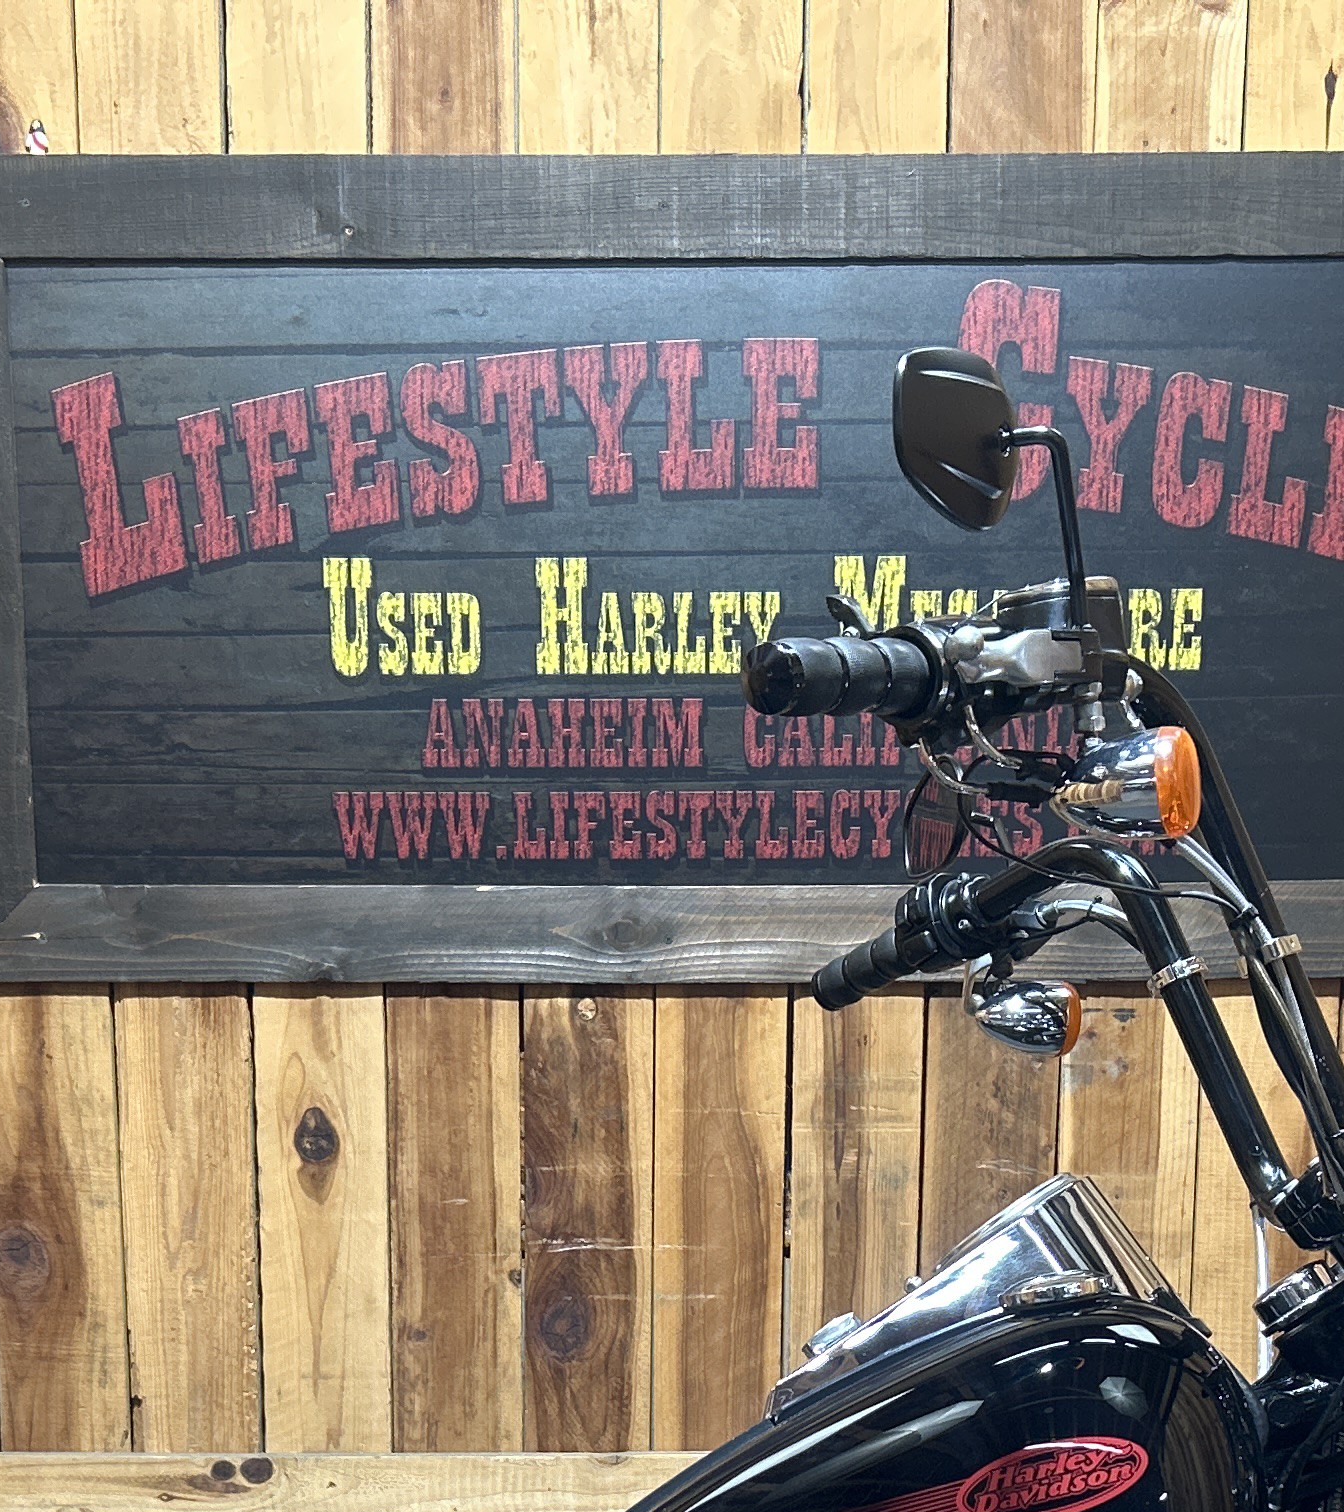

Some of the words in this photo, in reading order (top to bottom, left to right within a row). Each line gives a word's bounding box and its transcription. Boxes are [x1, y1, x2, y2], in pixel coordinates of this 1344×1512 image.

[51, 337, 820, 598] LIFESTYLE
[323, 556, 482, 677] USED
[534, 556, 781, 676] HARLEY
[421, 698, 705, 769] ANAHEIM
[986, 1446, 1108, 1492] Harley
